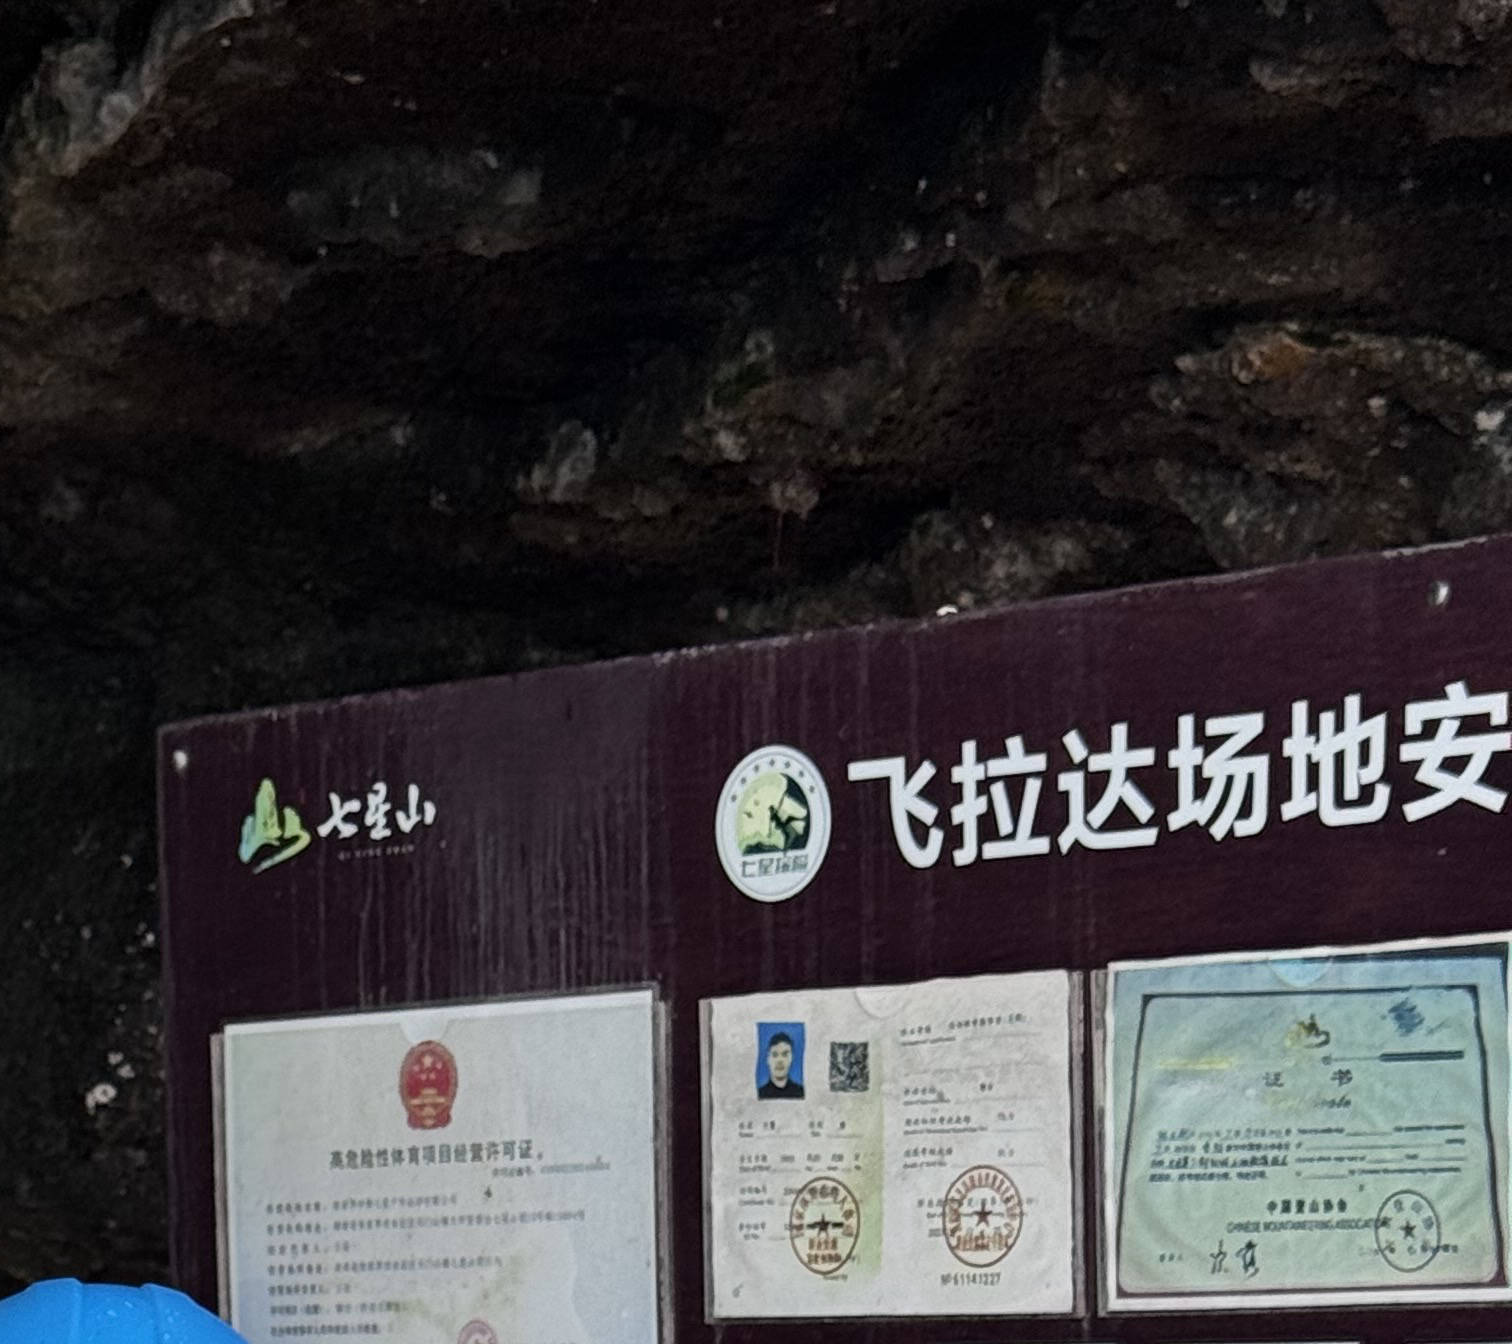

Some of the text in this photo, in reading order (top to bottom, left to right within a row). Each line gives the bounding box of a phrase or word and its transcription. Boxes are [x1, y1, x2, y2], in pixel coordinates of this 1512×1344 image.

[317, 781, 436, 840] 七星山
[848, 681, 1512, 870] 飞拉达场地安
